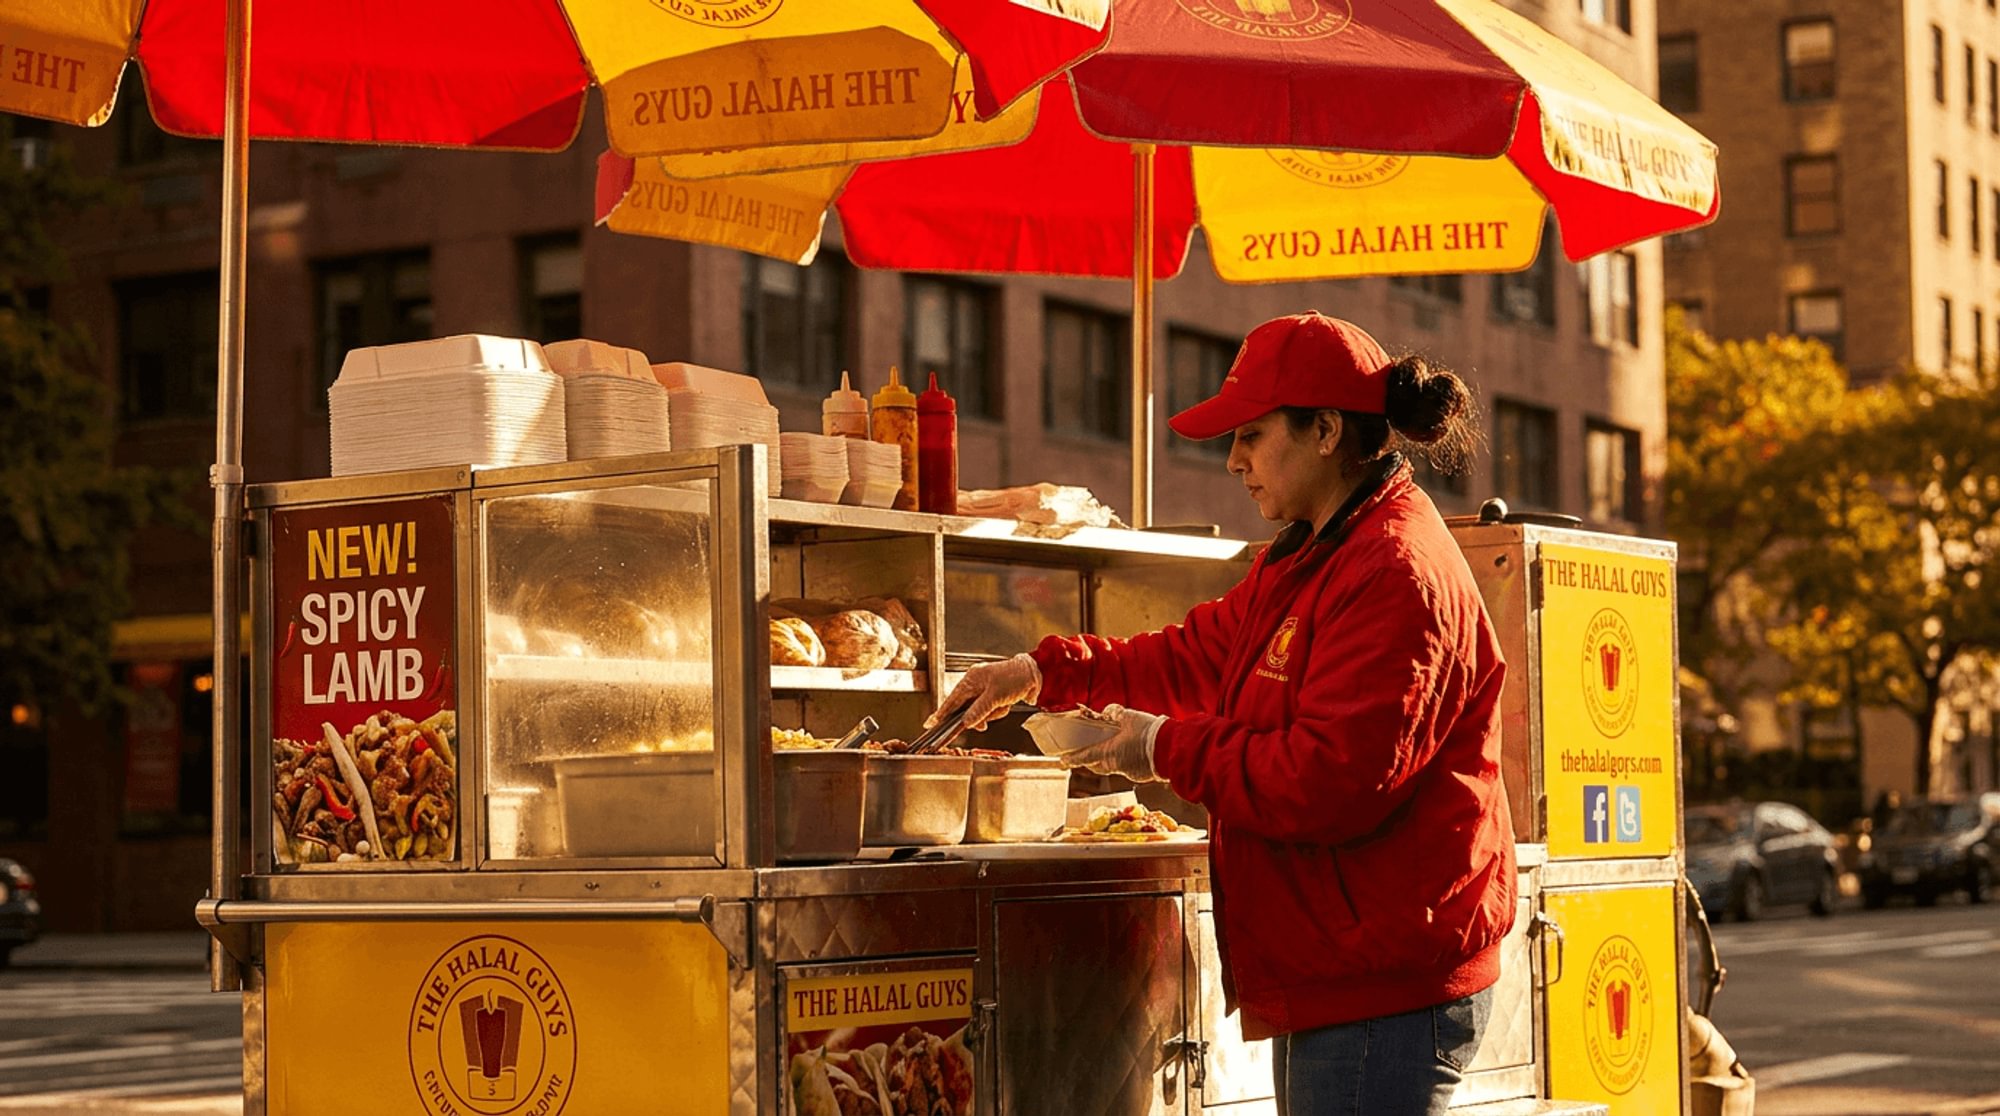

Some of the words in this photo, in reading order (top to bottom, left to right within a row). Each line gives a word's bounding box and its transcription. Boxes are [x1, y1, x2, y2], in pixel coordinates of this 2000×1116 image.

[1591, 126, 1648, 173] HALAL
[308, 521, 417, 581] NEW!
[1545, 559, 1577, 587] THE
[1581, 563, 1628, 593] HALAL
[1631, 569, 1666, 598] GUYS
[301, 586, 426, 646] SPICY
[303, 648, 424, 705] LAMB
[416, 975, 450, 1033] THE
[446, 946, 520, 984] HALAL
[525, 966, 568, 1037] GUYS
[794, 988, 837, 1018] THE
[843, 983, 911, 1014] HALAL
[916, 978, 967, 1008] GUYS
